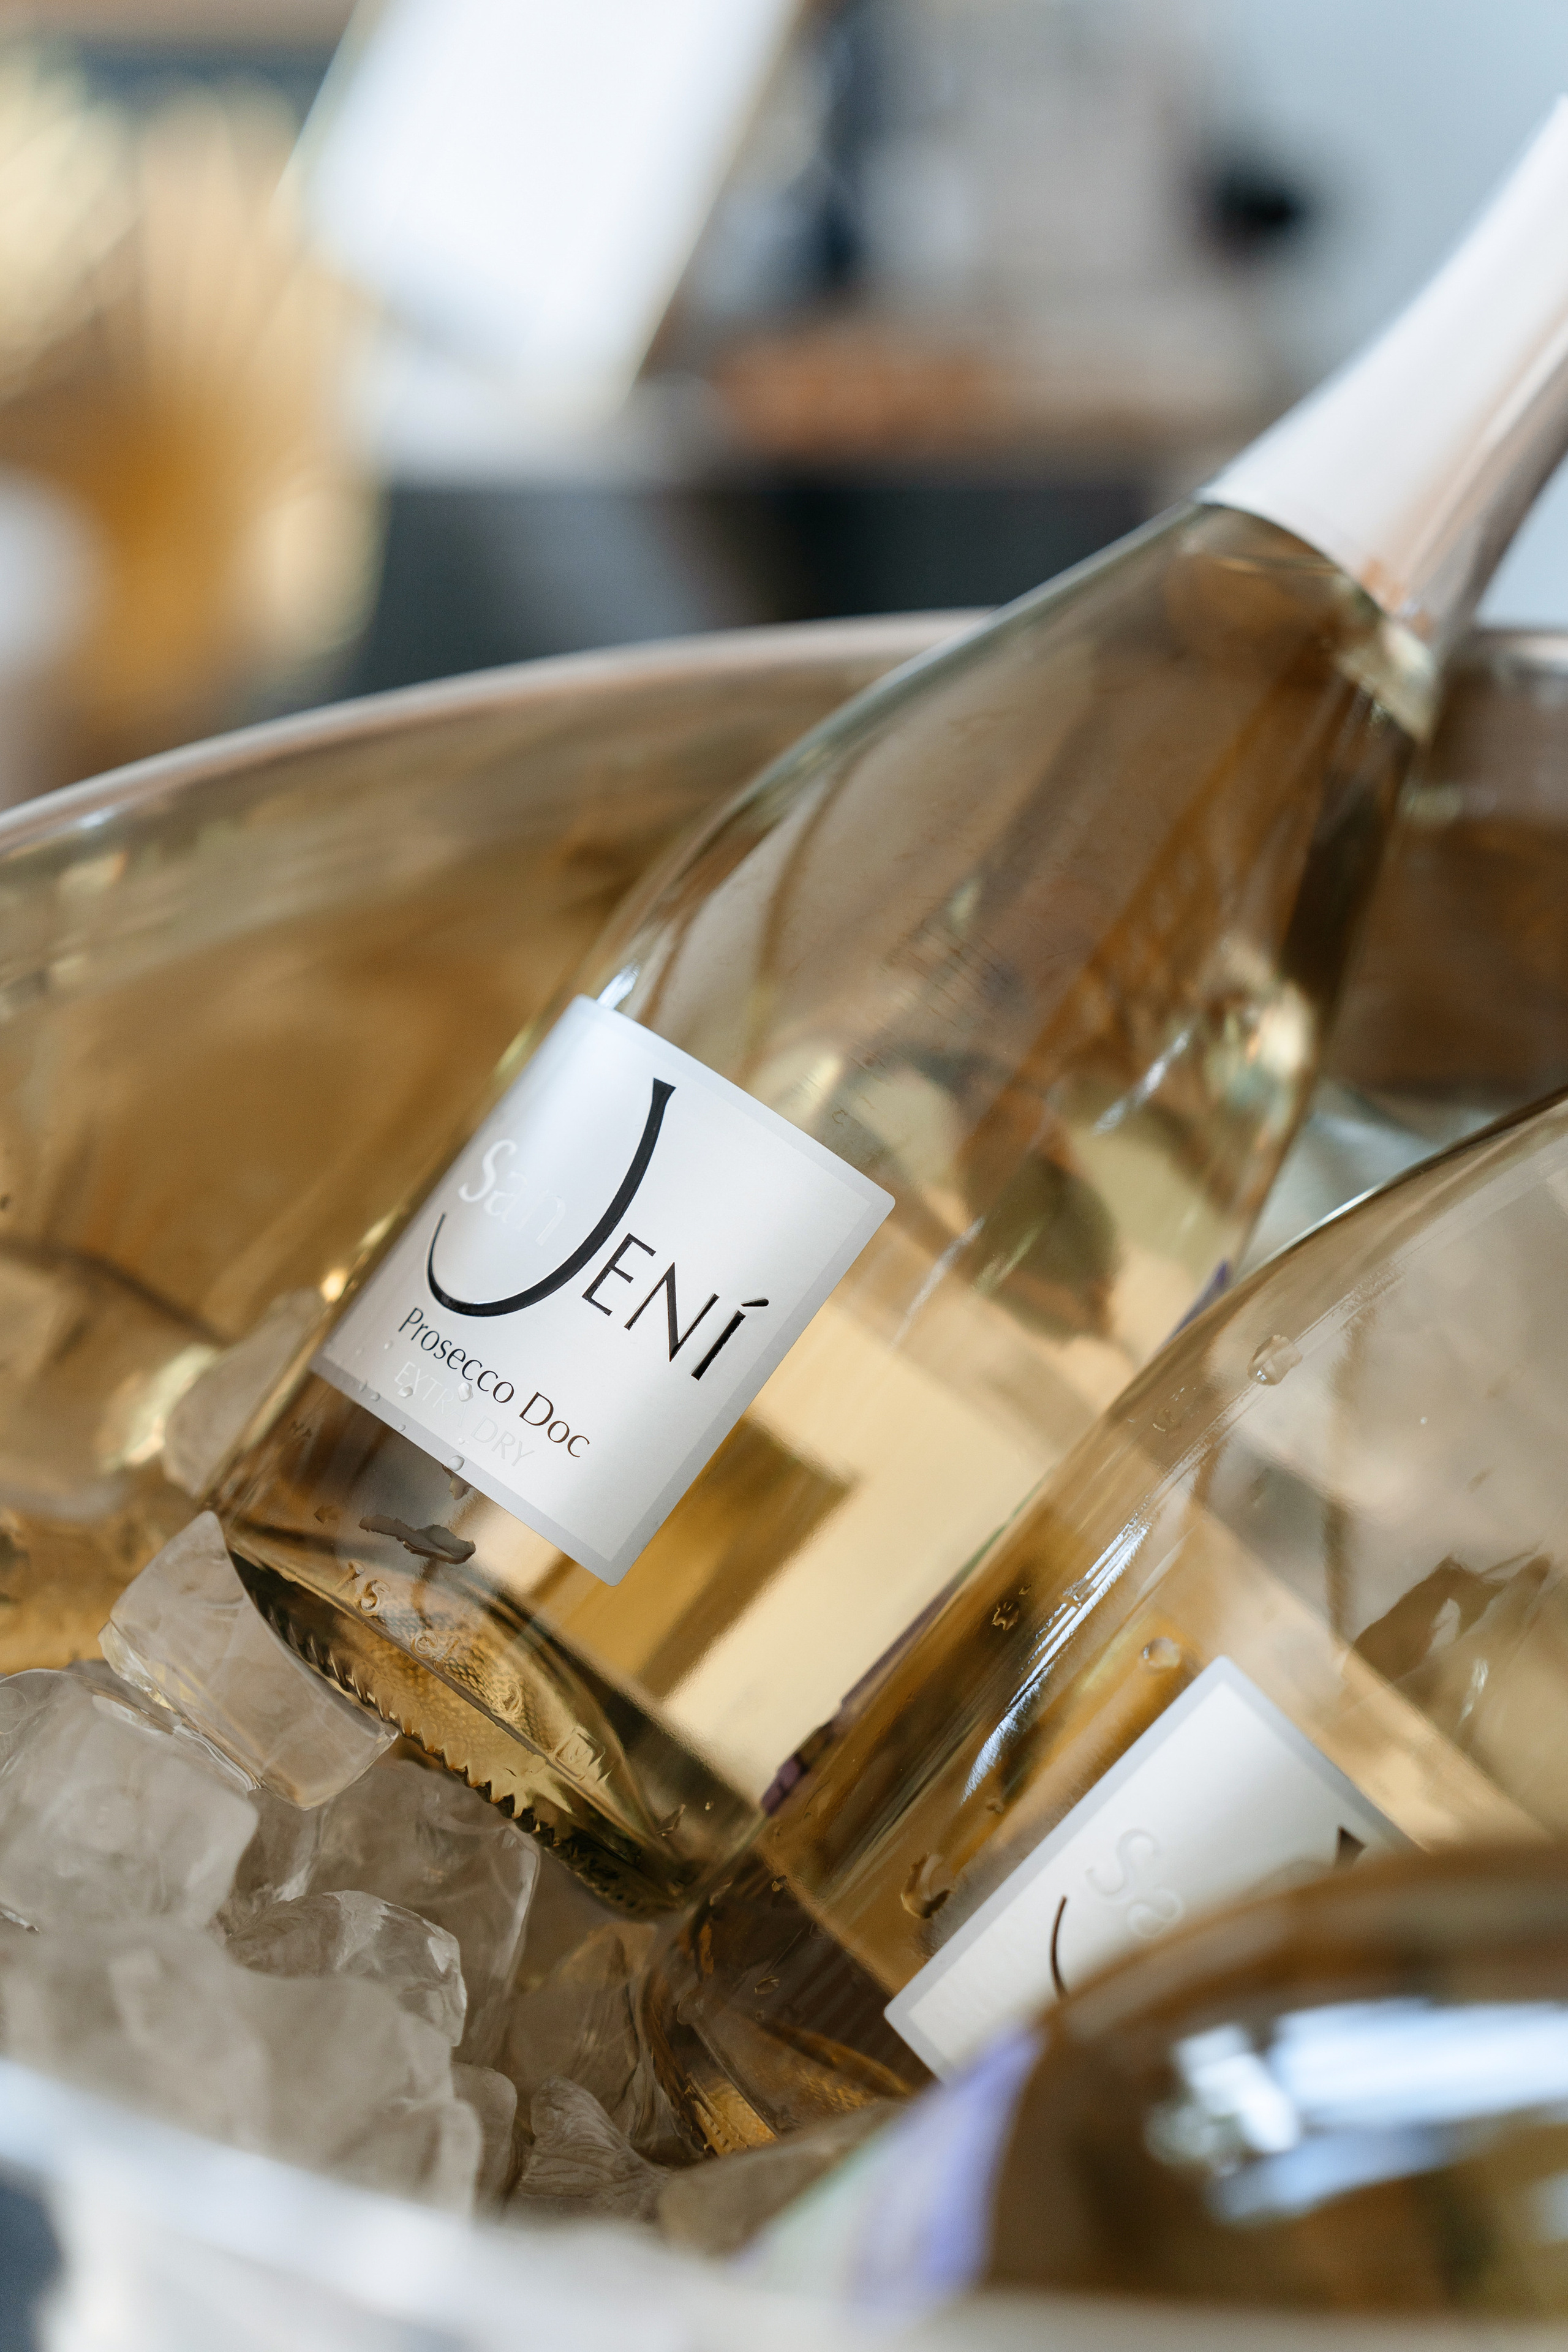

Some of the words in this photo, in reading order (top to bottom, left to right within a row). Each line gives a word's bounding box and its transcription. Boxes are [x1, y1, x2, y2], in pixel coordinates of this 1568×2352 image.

[459, 1139, 566, 1247] San
[398, 1306, 514, 1403] Prosecco
[519, 1392, 590, 1458] Doc
[470, 1415, 535, 1467] DRY
[1085, 1827, 1186, 1940] Sa
